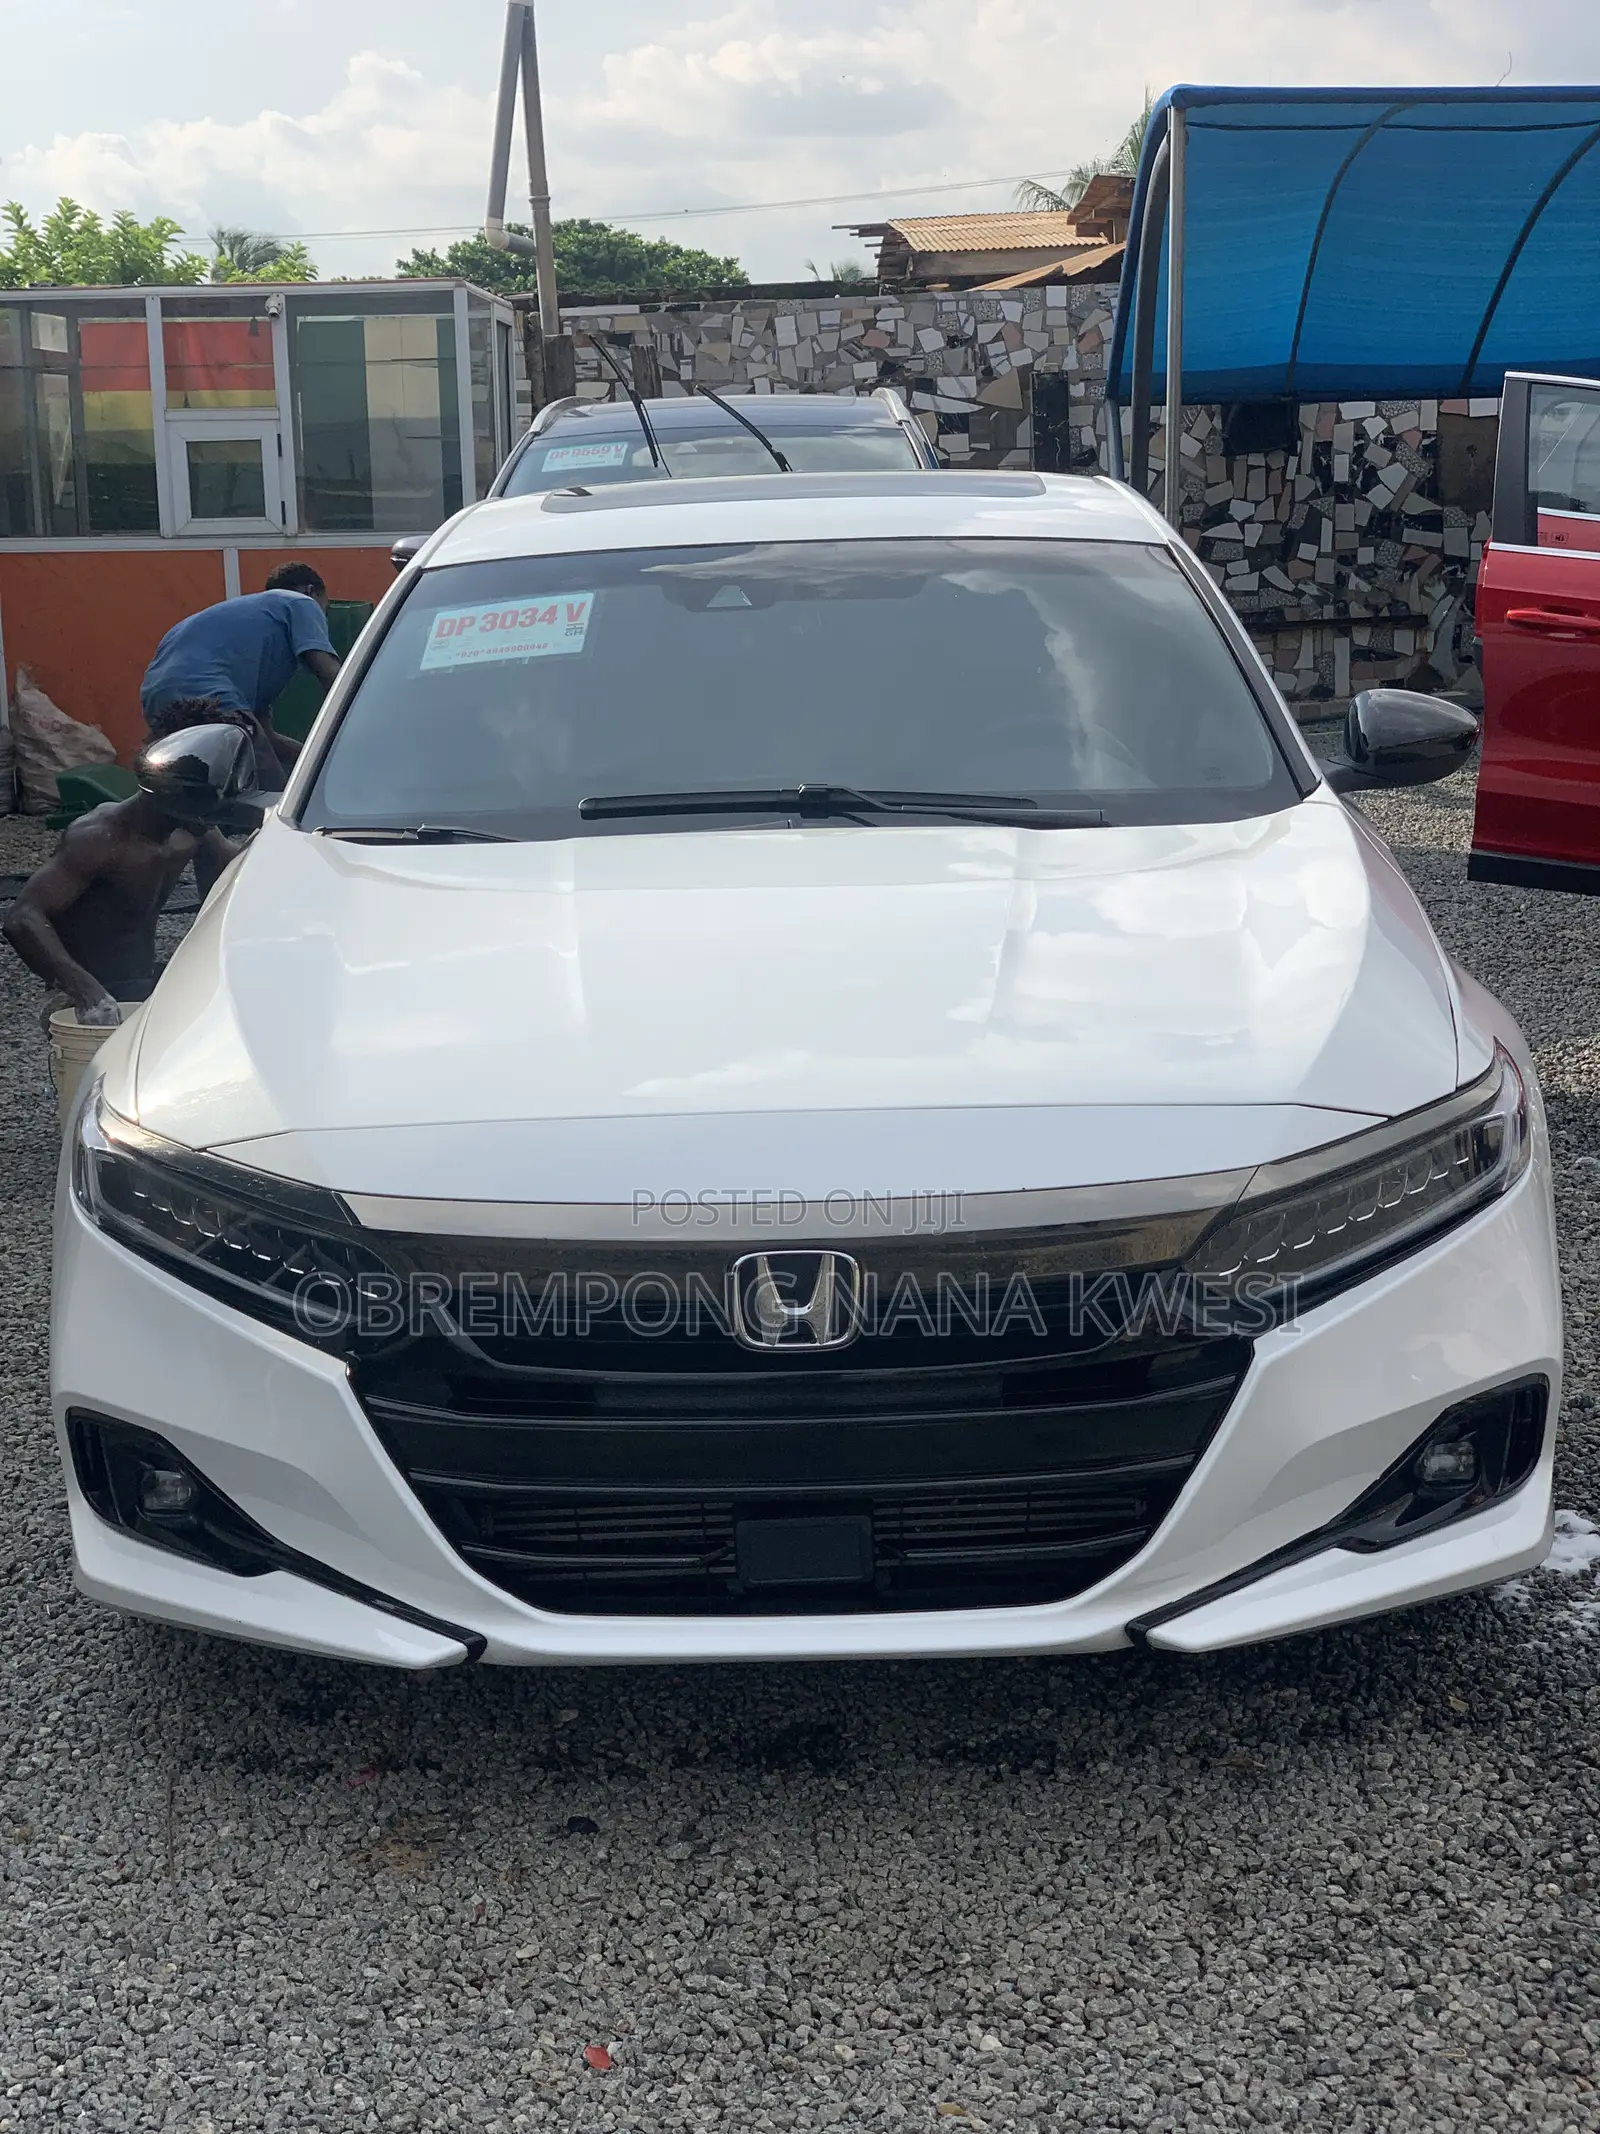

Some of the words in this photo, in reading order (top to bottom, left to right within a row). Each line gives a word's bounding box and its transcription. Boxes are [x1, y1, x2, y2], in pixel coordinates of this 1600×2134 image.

[549, 450, 570, 460] DP
[613, 443, 625, 453] V
[435, 616, 476, 638] DP
[479, 604, 558, 633] 3034
[566, 602, 587, 623] V
